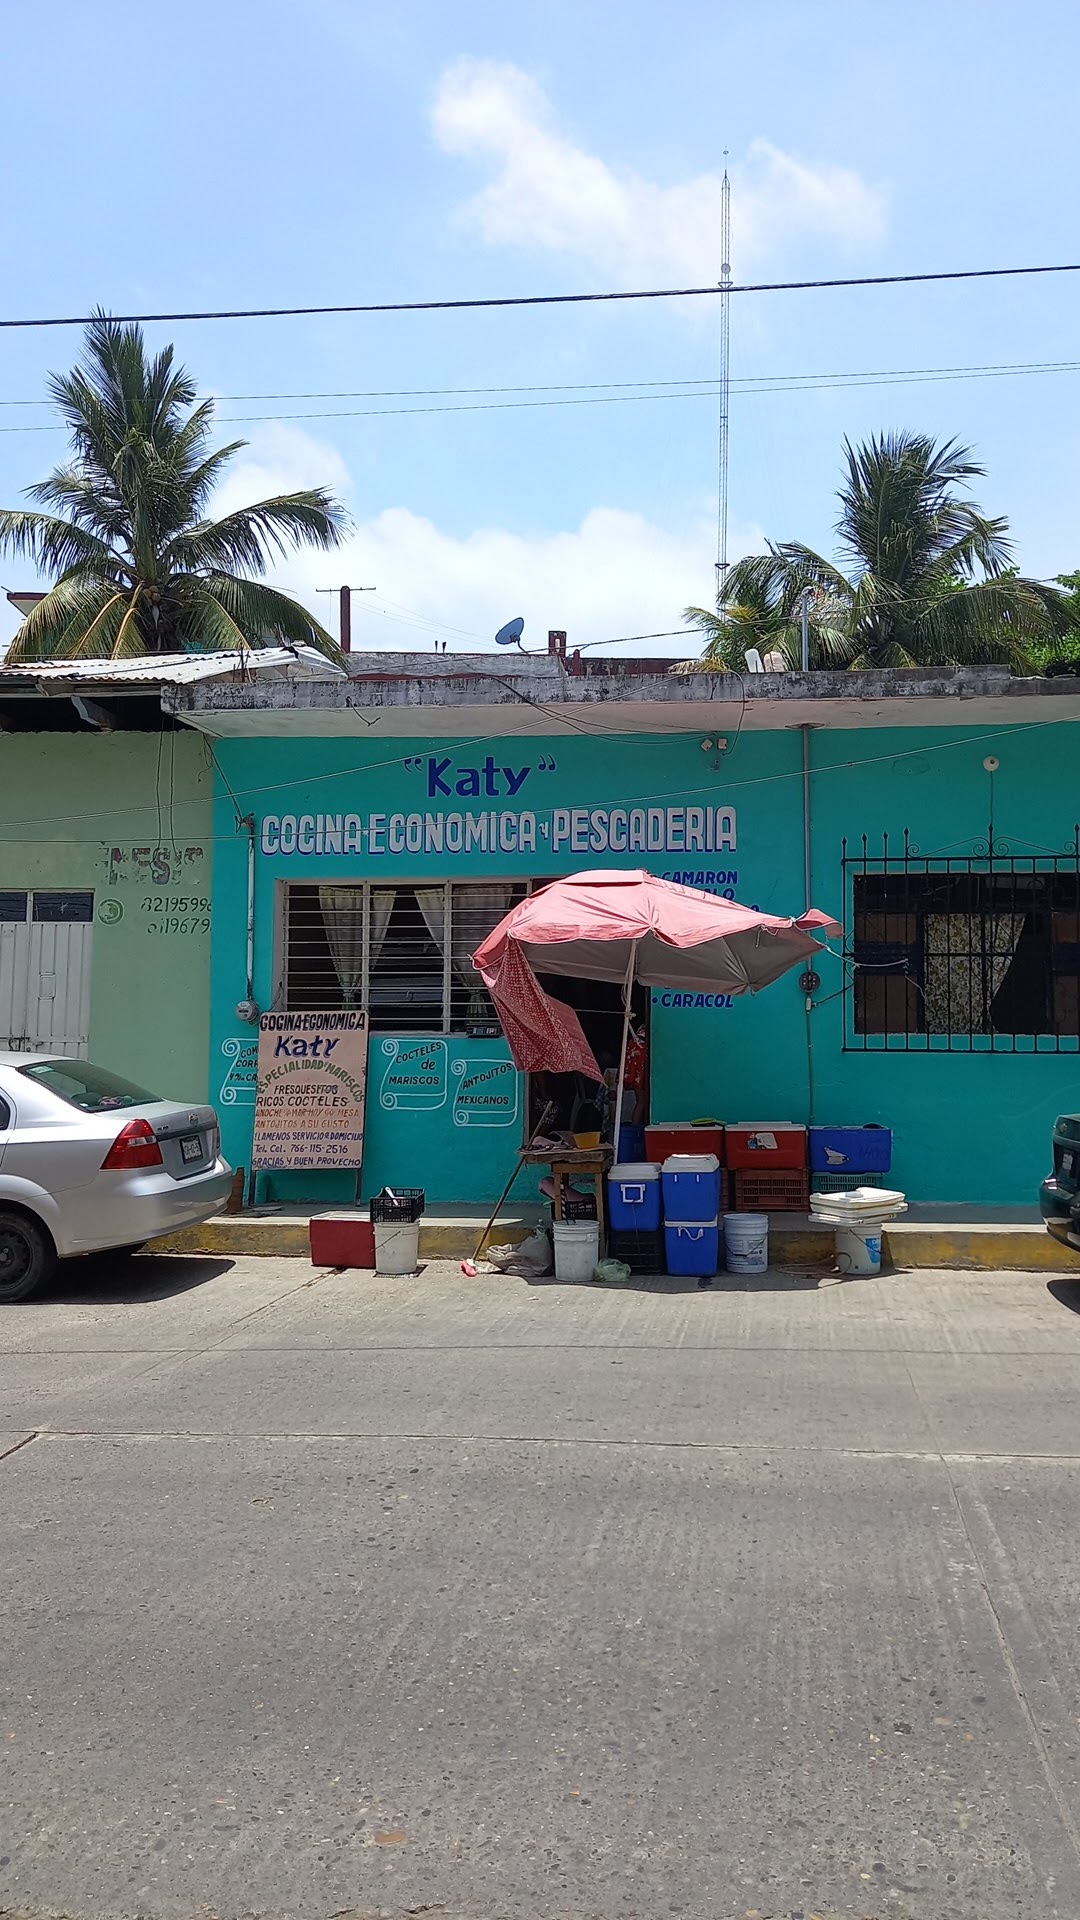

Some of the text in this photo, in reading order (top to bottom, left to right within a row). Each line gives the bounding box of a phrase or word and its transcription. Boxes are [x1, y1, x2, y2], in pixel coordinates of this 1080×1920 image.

[261, 814, 362, 856] COCINA
[368, 811, 536, 854] ECONOMICA
[552, 806, 737, 854] PESCADERIA
[662, 871, 738, 885] CAMARON
[661, 993, 734, 1008] CARACOL
[260, 1012, 366, 1031] COCINA ECONOMICA
[273, 1035, 341, 1058] Katy
[395, 1041, 442, 1064] COCTELES
[421, 1057, 436, 1071] de
[256, 1059, 365, 1102] ESPECIALIDAD MARISCOS
[388, 1076, 440, 1085] MARISCOS
[462, 1062, 514, 1090] ANTOJITOS
[256, 1096, 349, 1107] RICOS COCTELES
[456, 1096, 510, 1105] MEXICANOS
[255, 1120, 349, 1128] ANTOJITOS A SU GUSTO
[292, 1132, 325, 1141] SERVICIO
[330, 1132, 364, 1141] DOMICILIO
[270, 1145, 286, 1153] Cel.
[291, 1144, 348, 1154] 766-115-2516
[253, 1157, 284, 1166] GRACIAS
[294, 1157, 313, 1166] BUEN
[317, 1157, 360, 1166] PROVECHO
